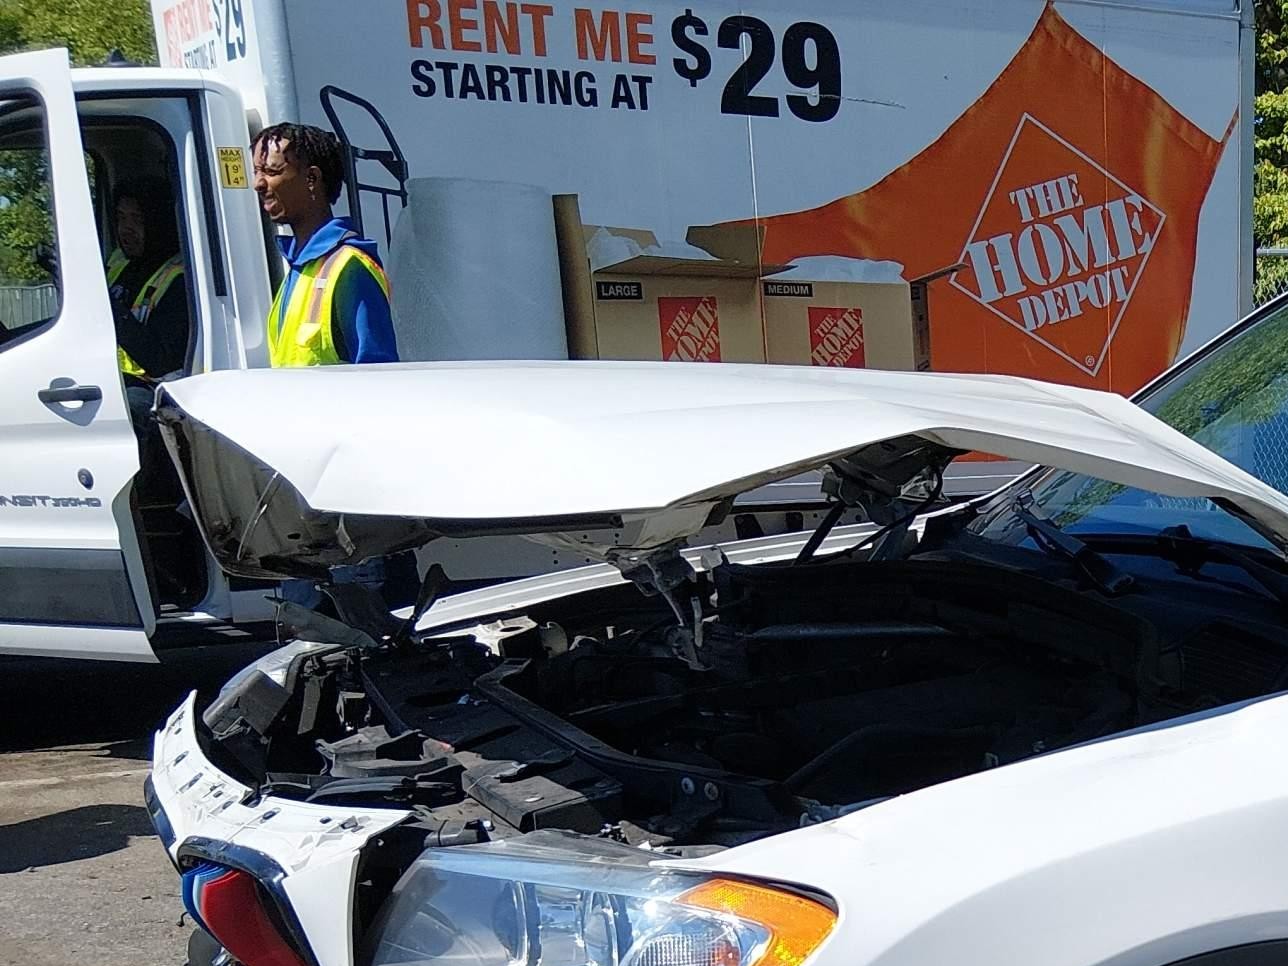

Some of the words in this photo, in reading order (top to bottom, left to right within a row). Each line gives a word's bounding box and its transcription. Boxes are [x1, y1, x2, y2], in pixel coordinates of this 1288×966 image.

[407, 0, 553, 57] RENT
[575, 8, 656, 65] ME
[411, 60, 599, 107] STARTING
[611, 74, 653, 110] AT
[671, 9, 841, 122] $29
[1008, 173, 1084, 223] THE
[966, 194, 1151, 303] HOME
[601, 285, 638, 297] LARGE
[768, 285, 809, 295] MEDIUM
[1017, 266, 1128, 332] DEPOT
[666, 305, 691, 342] THE
[668, 297, 718, 361] OME
[812, 308, 864, 366] HOME
[814, 313, 837, 338] THE
[832, 331, 864, 366] DEPOT
